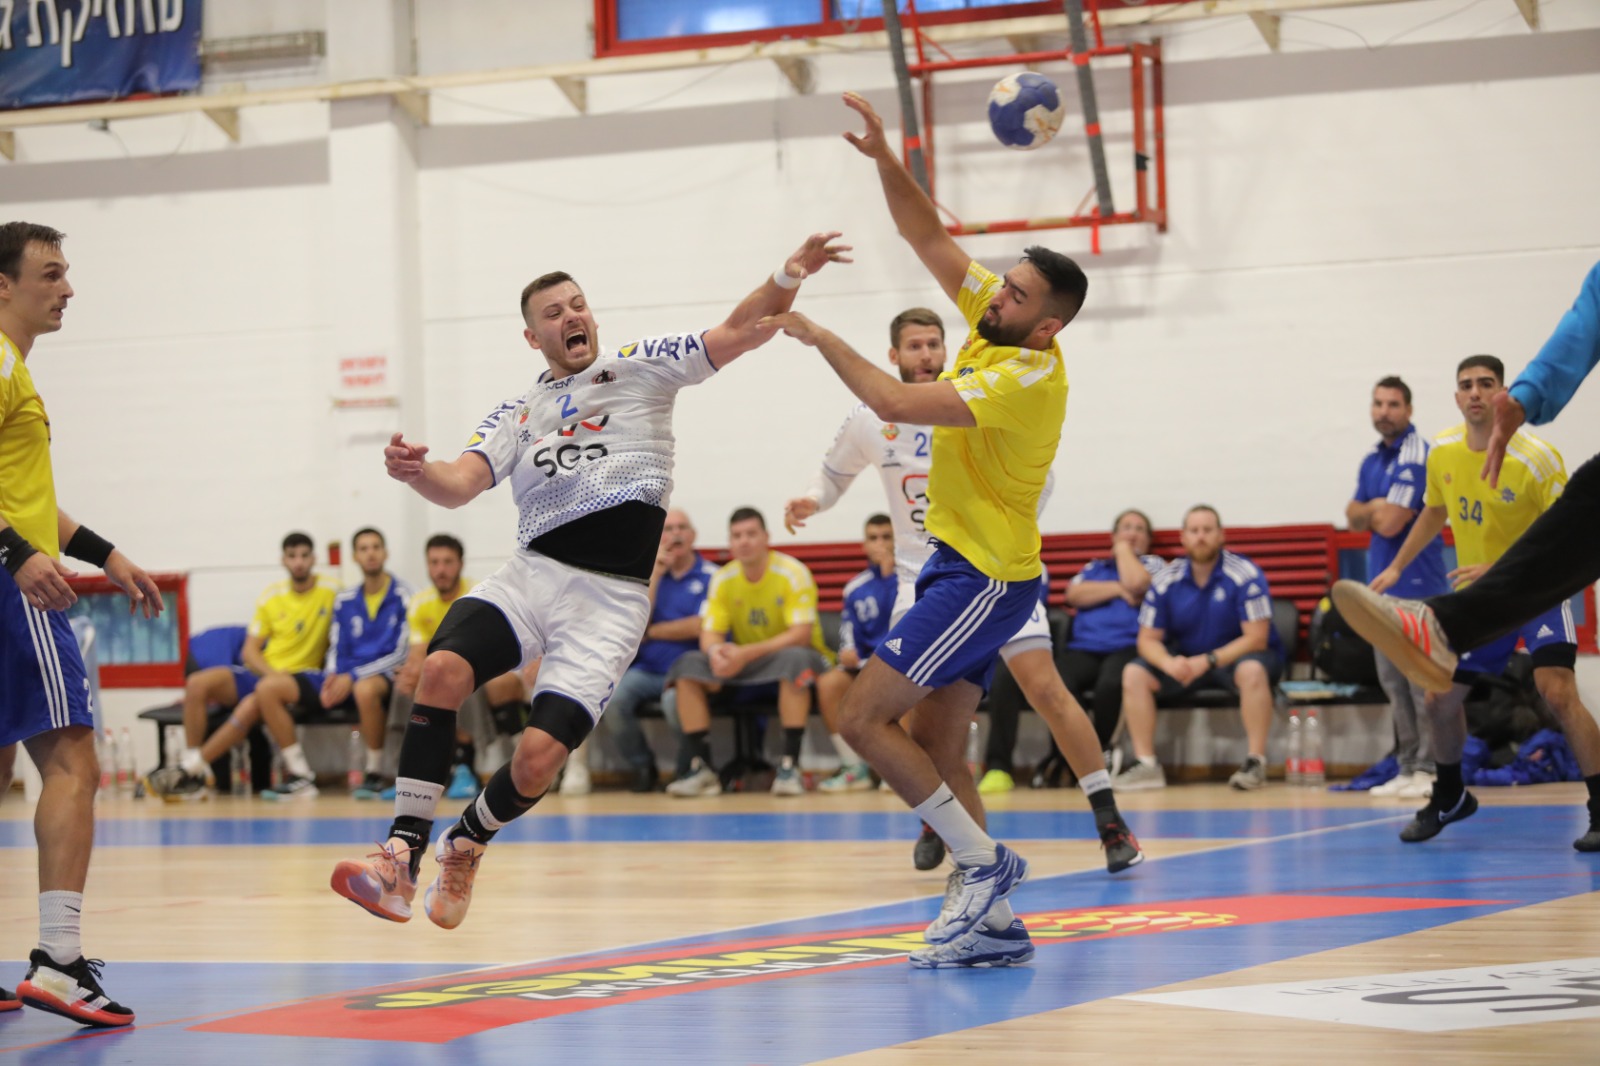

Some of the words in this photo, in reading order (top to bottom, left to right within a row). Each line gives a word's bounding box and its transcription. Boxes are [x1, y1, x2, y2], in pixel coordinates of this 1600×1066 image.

[643, 333, 700, 360] VARA
[556, 393, 579, 419] 2
[914, 431, 933, 456] 2
[1459, 495, 1483, 525] 34
